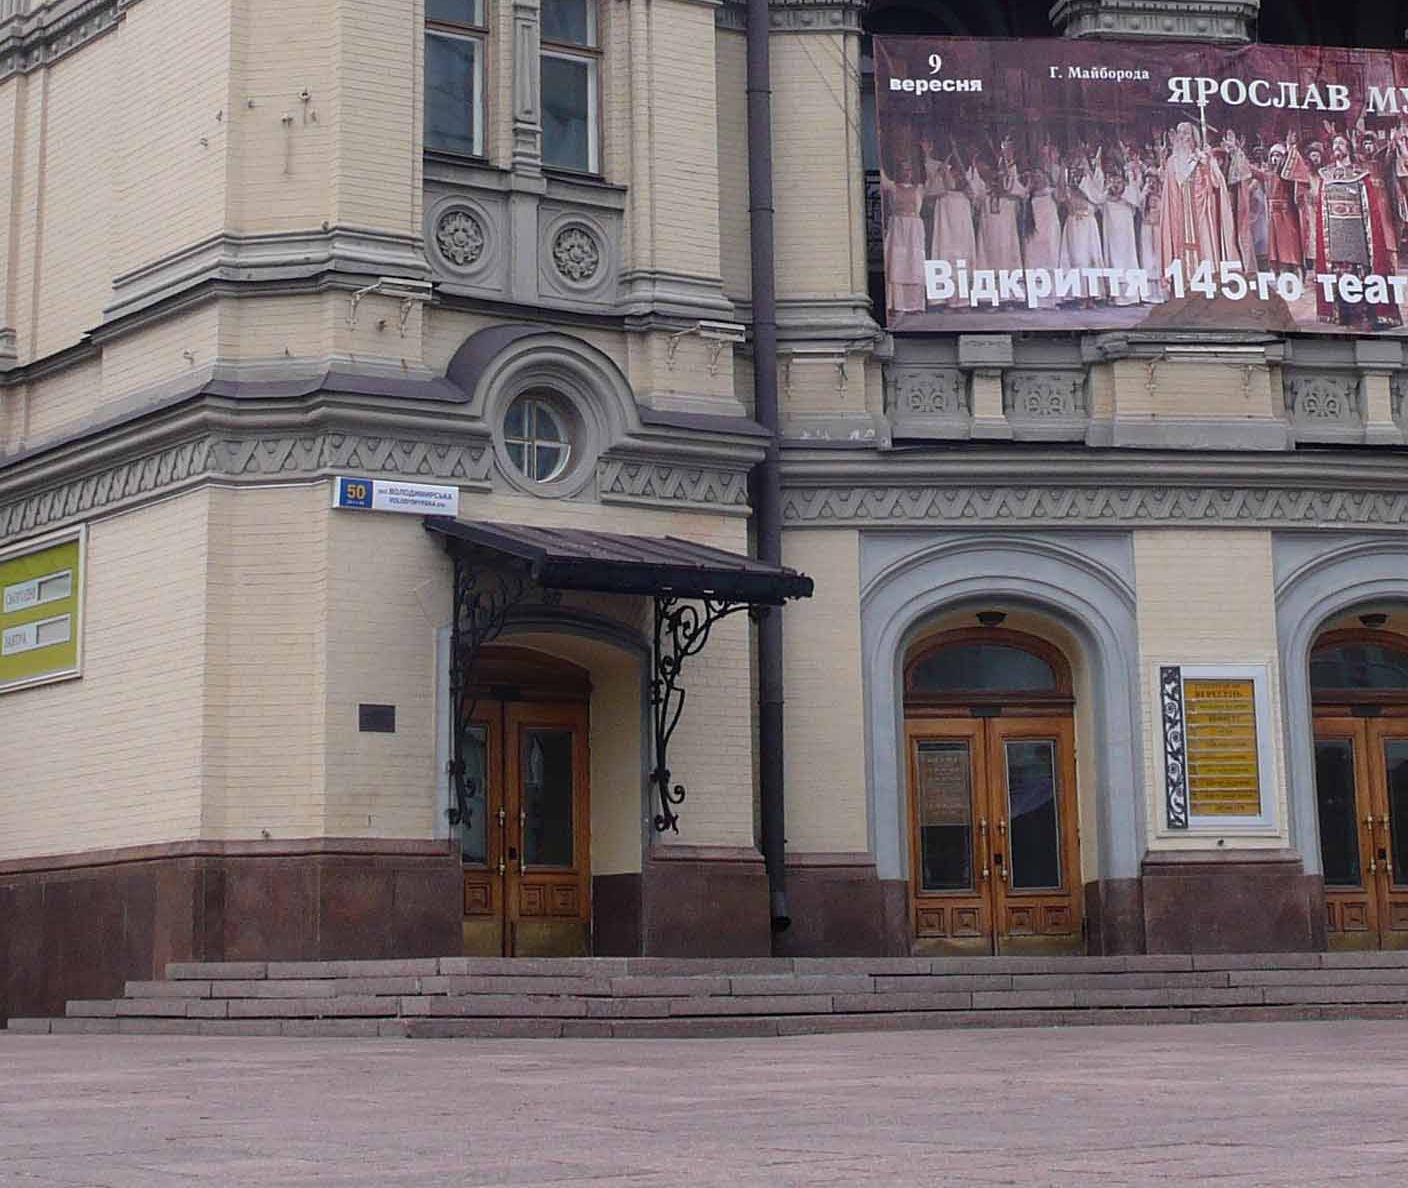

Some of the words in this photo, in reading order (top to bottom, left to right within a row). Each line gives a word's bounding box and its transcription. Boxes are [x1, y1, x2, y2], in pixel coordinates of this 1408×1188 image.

[928, 53, 942, 75] 9
[1049, 66, 1063, 79] Г.
[1068, 66, 1150, 83] Майборода
[889, 77, 983, 95] вересня
[1167, 76, 1351, 111] ЯРОСЛАВ
[923, 260, 1150, 308] Відкриття
[1165, 259, 1304, 301] 145-го
[347, 484, 366, 500] 50
